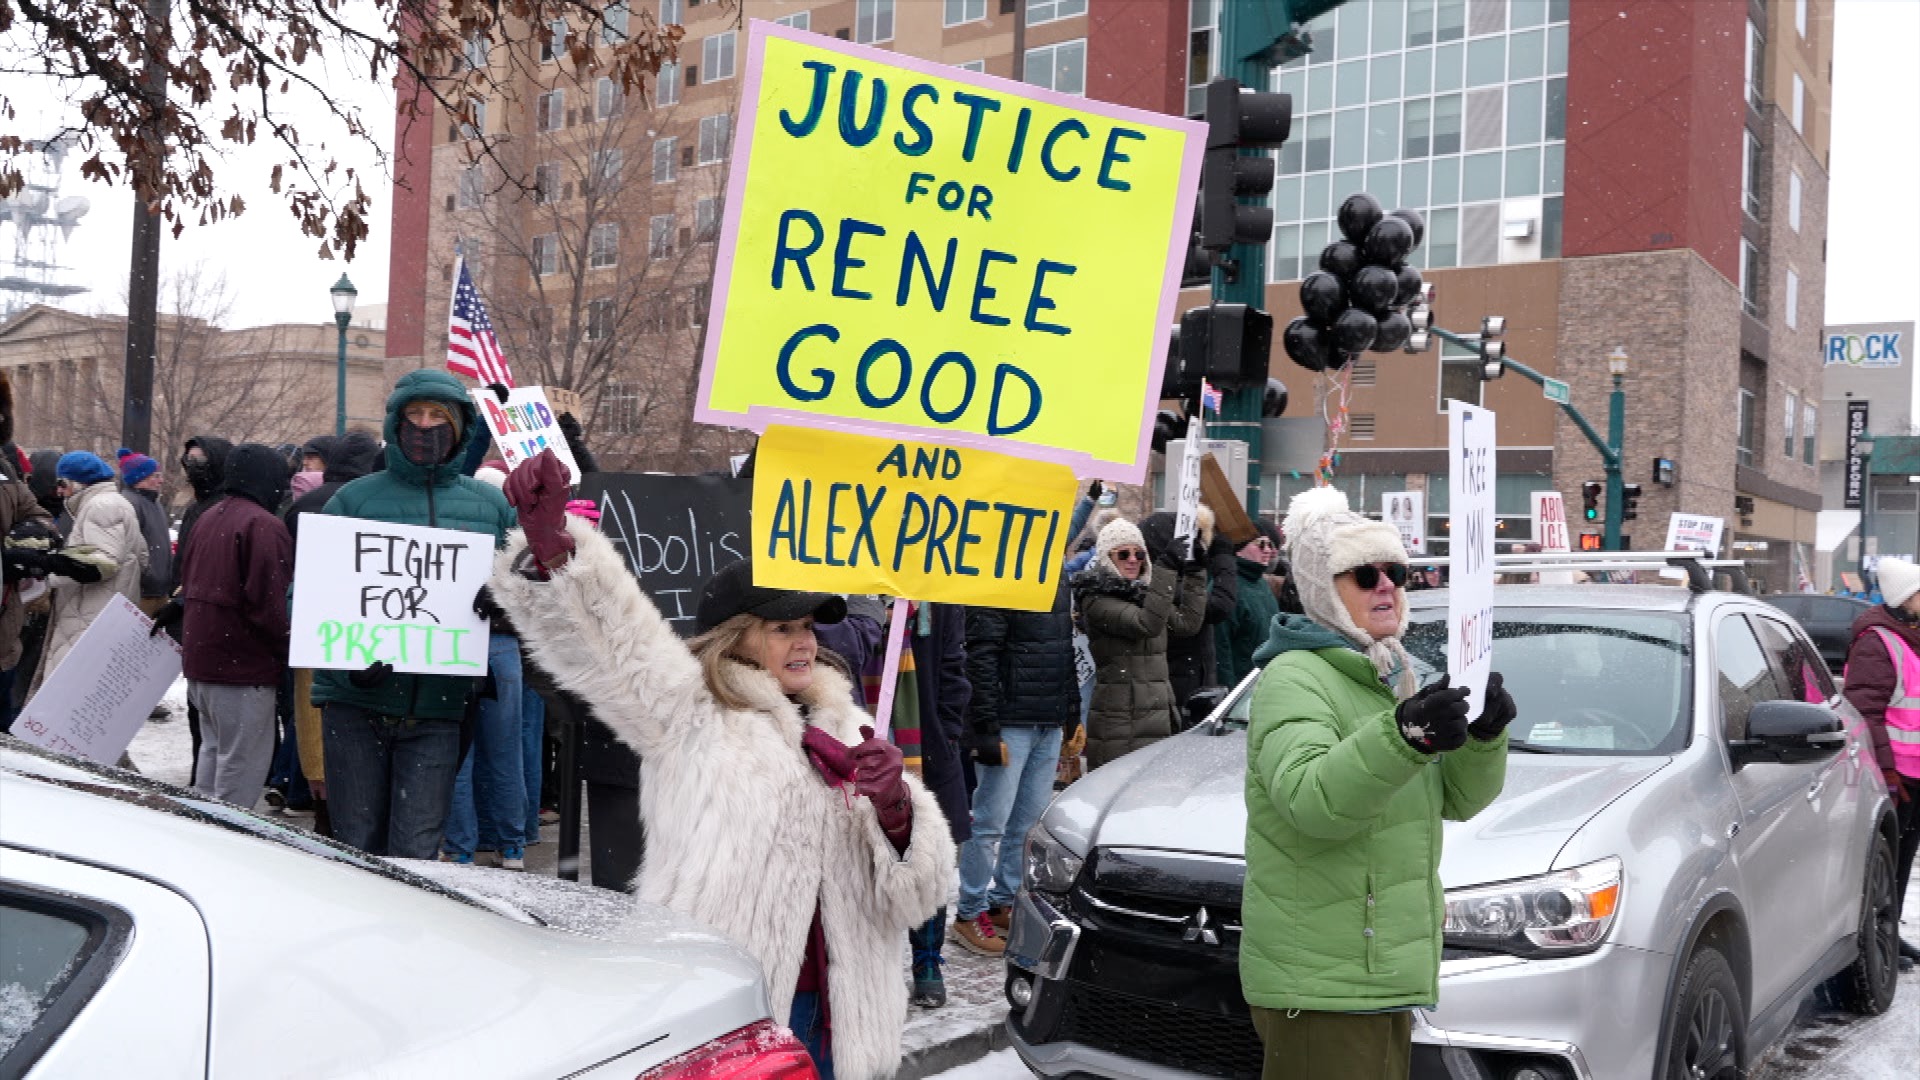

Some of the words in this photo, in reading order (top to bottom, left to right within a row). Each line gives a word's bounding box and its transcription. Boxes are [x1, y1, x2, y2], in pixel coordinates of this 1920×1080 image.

[778, 60, 1147, 192] JUSTICE
[904, 171, 994, 221] FOR
[771, 208, 1078, 336] RENEE
[1824, 333, 1900, 365] ROCK
[776, 323, 1043, 436] GOOD
[483, 397, 553, 437] DEFUND
[876, 443, 962, 481] AND
[1462, 411, 1487, 496] FREE
[355, 531, 469, 585] FIGHT
[597, 489, 753, 579] Abolis
[767, 478, 888, 568] ALEX
[891, 491, 1061, 585] PRETTI
[1465, 509, 1485, 575] MN
[360, 585, 441, 624] FOR
[317, 619, 481, 667] PRETTI
